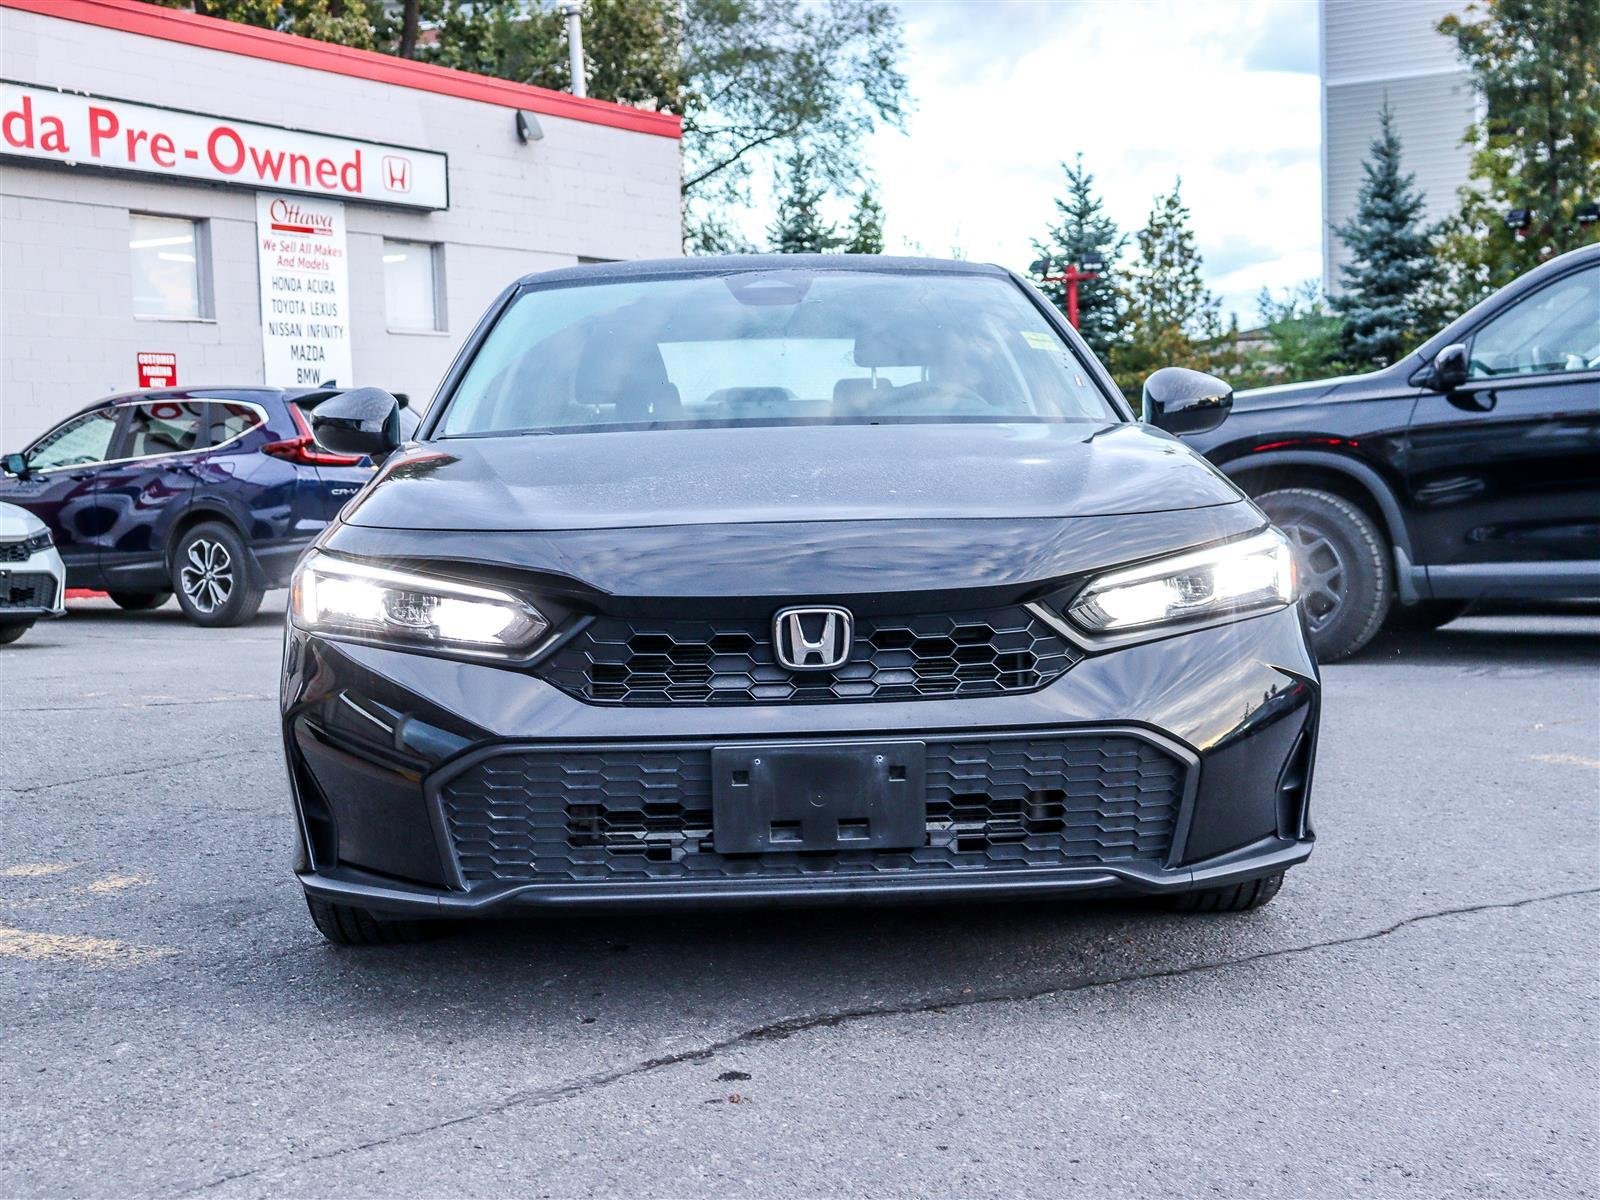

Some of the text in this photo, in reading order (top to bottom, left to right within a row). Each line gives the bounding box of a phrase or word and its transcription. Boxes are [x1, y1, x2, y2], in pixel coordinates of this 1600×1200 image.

[88, 106, 362, 194] Pre-Owned
[270, 198, 333, 228] Ottawa
[263, 239, 342, 257] We Sell All Makes
[277, 255, 330, 271] And Models
[271, 276, 336, 294] HONDA ACURA
[272, 298, 338, 317] TOYOTA LEXUS
[268, 321, 344, 339] NISSAN INFINITY
[138, 354, 175, 365] CUSTOMER
[290, 344, 326, 361] MAZDA
[297, 368, 321, 384] BMW
[331, 488, 359, 496] CR-V
